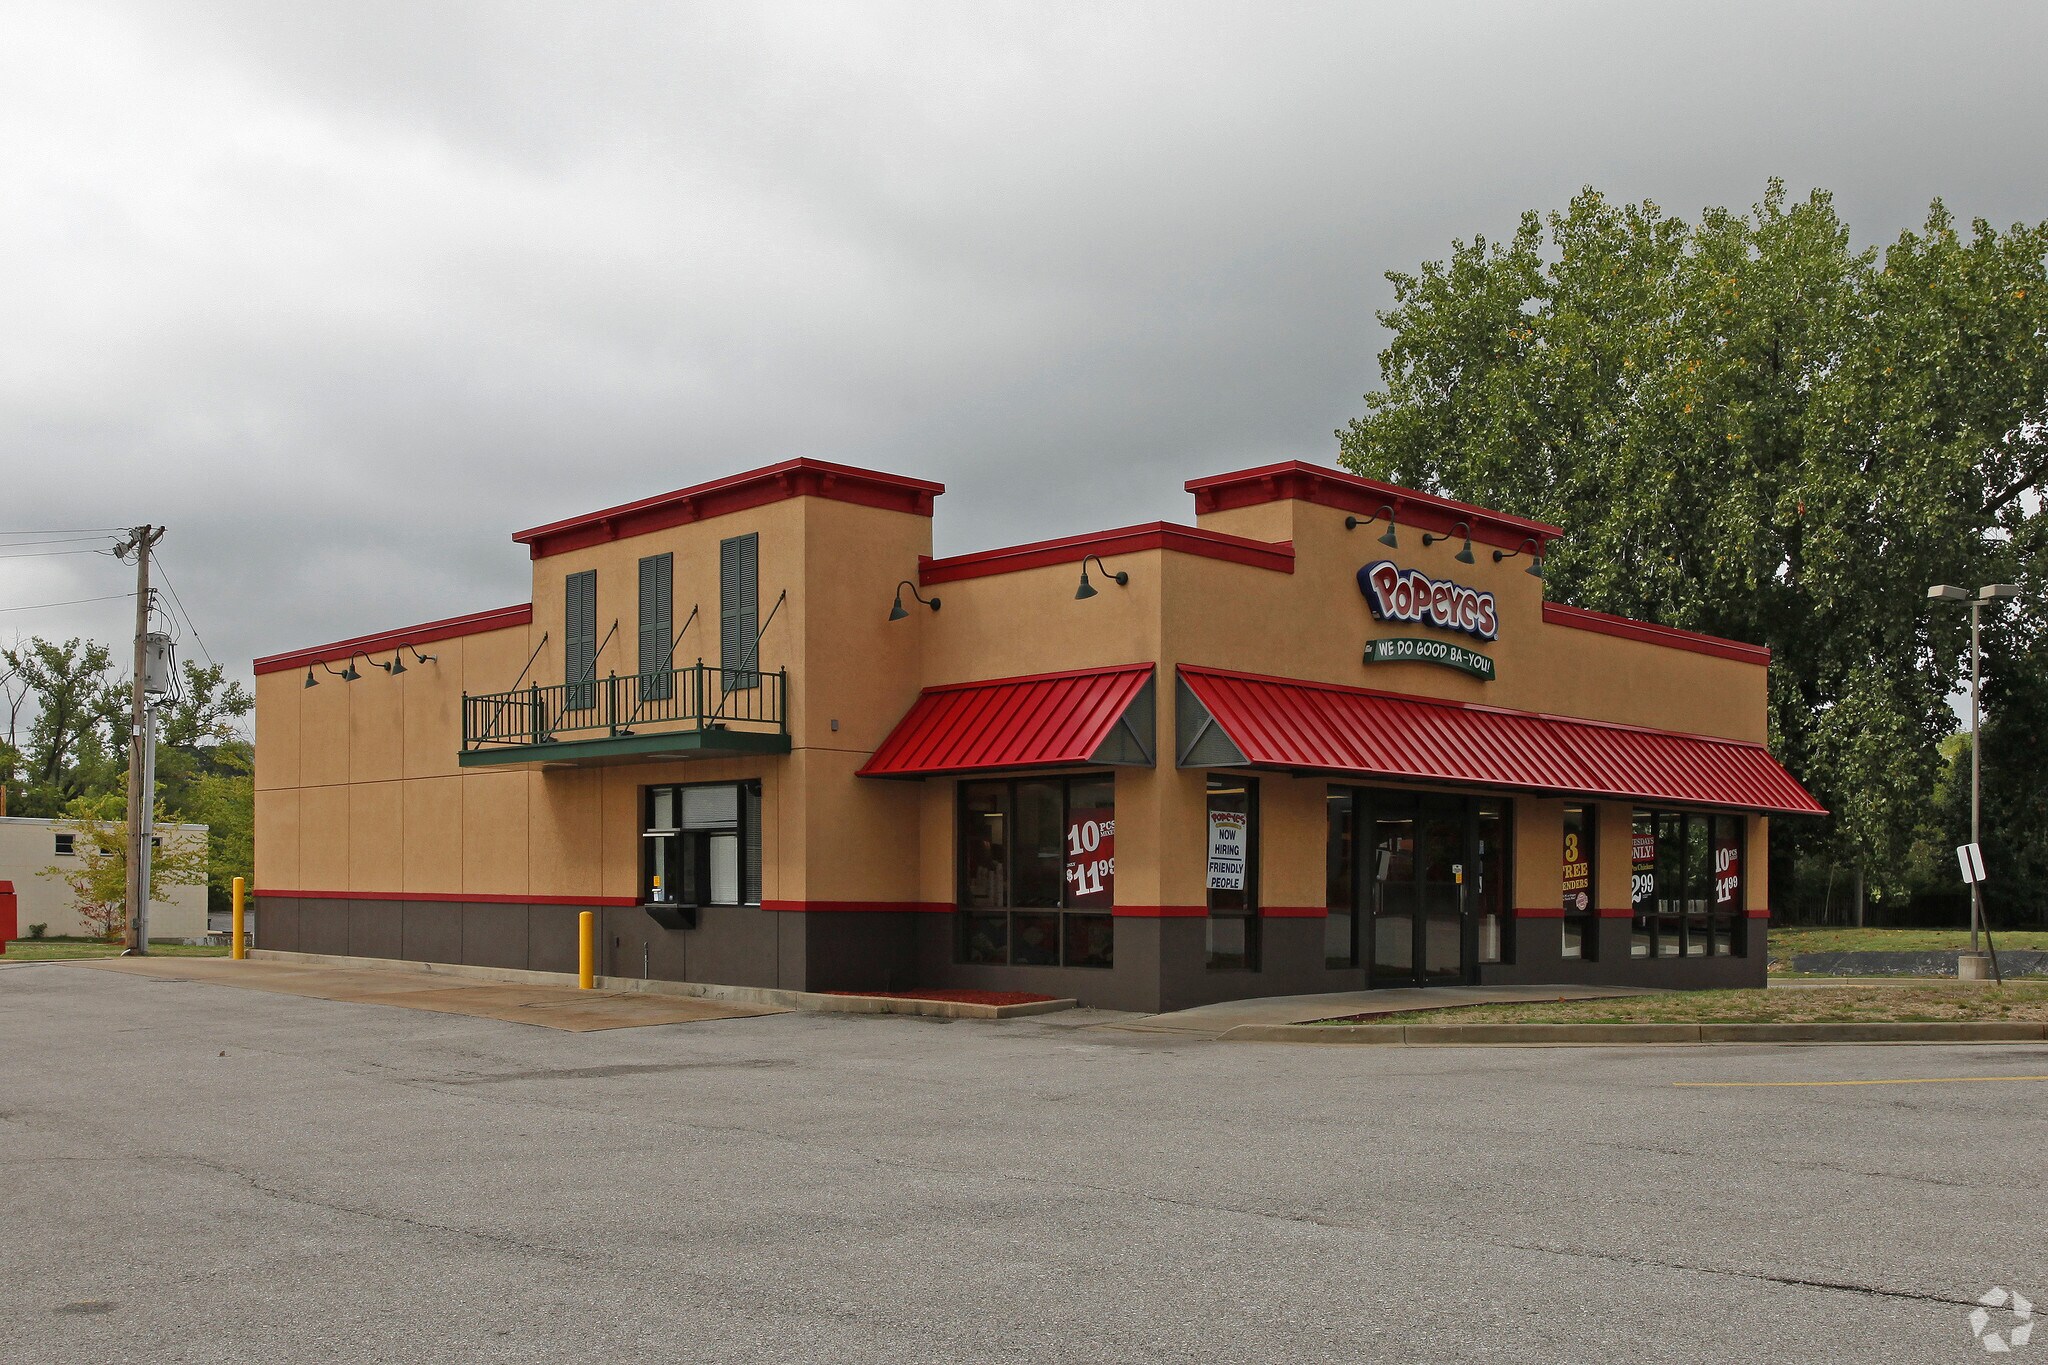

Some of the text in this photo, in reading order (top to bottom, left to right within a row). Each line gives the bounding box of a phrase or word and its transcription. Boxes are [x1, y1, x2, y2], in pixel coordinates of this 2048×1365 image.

[1379, 641, 1491, 673] WE DO GOOD BA-YOU!
[1067, 820, 1100, 856] 10
[1219, 829, 1236, 840] NOW
[1565, 833, 1579, 862] 3
[1632, 837, 1654, 846] ESDAYS
[1215, 844, 1239, 856] HIRING
[1632, 845, 1654, 859] NLY!
[1716, 848, 1730, 873] 10
[1209, 862, 1243, 874] FRIENDLY
[1211, 877, 1239, 888] PEOPLE
[1563, 879, 1588, 890] ENDERS
